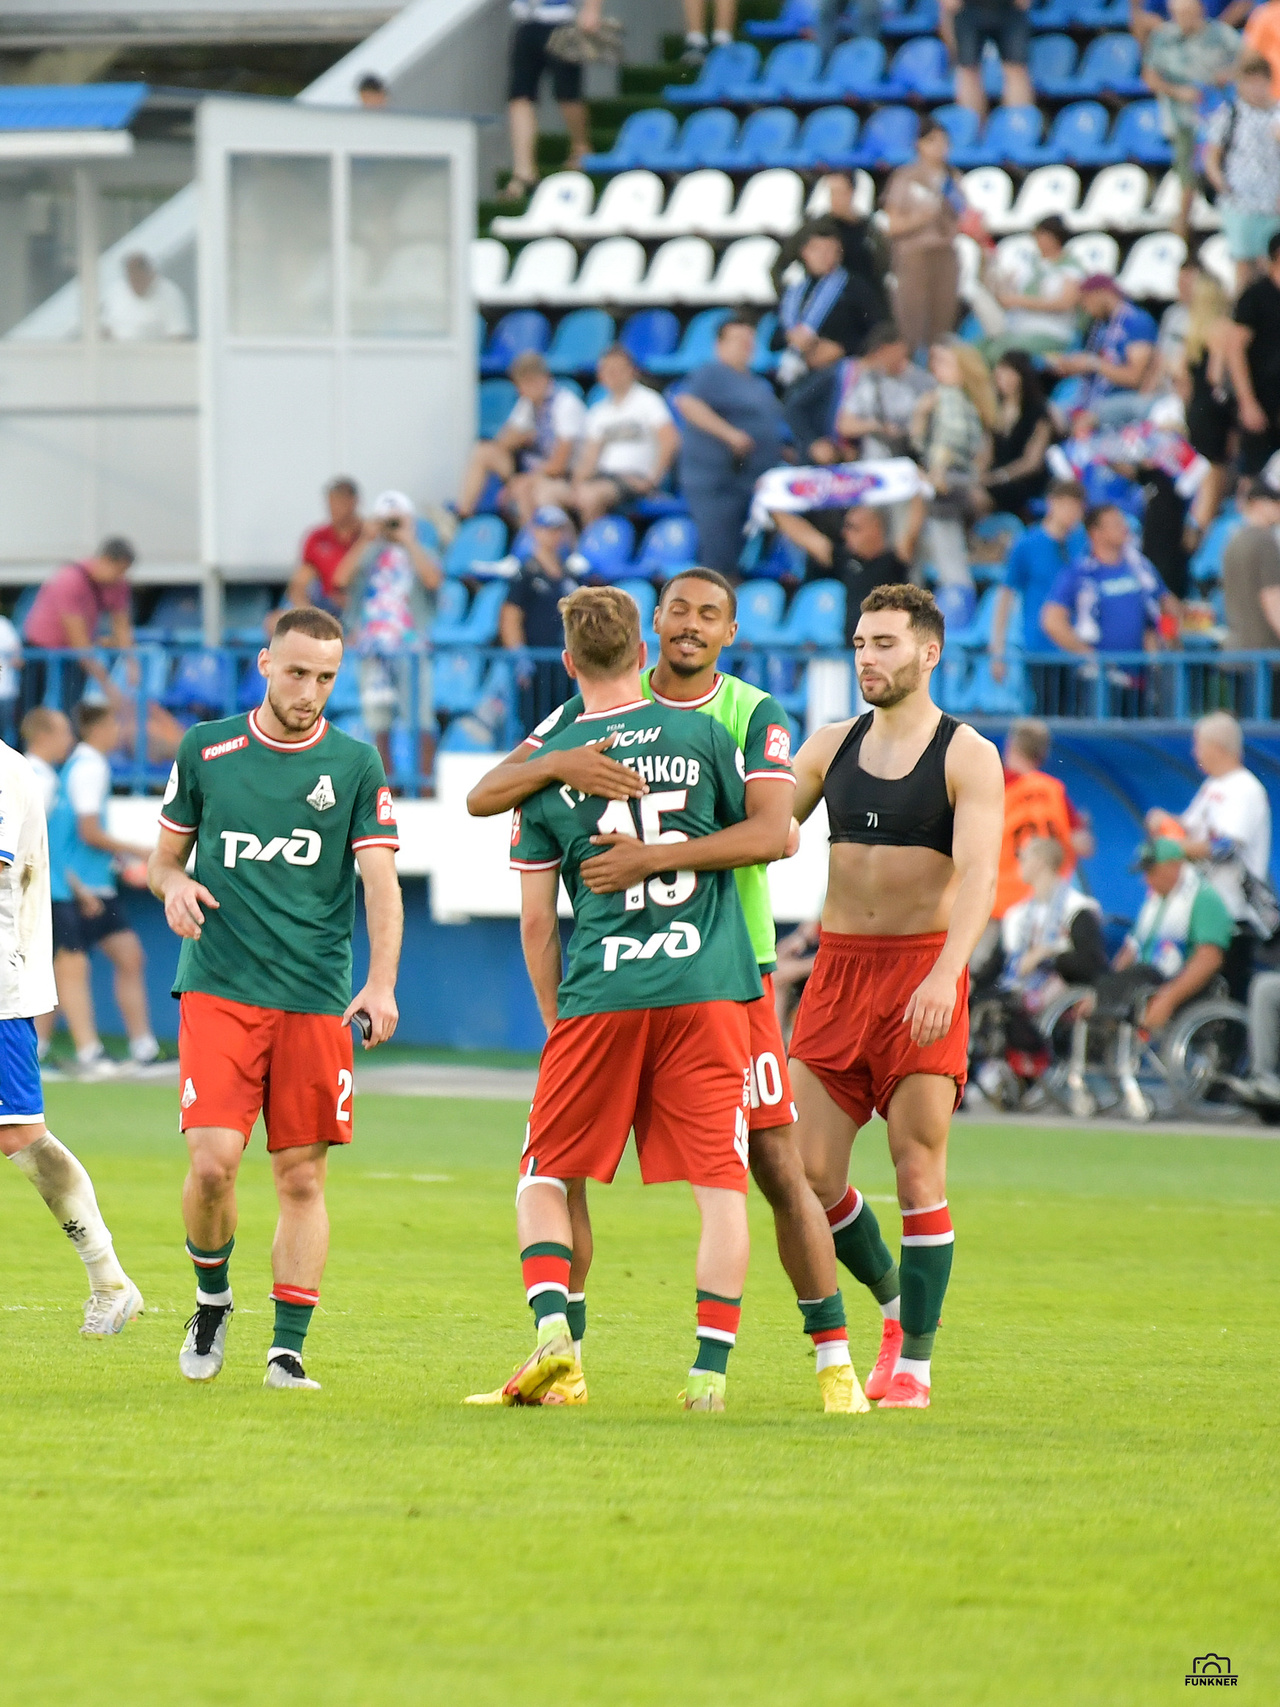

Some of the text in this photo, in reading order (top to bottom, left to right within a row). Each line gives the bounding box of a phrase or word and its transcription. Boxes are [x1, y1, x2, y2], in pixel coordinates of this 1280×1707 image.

[204, 736, 245, 760] FONBET
[597, 789, 699, 912] 15
[336, 1068, 353, 1122] 2
